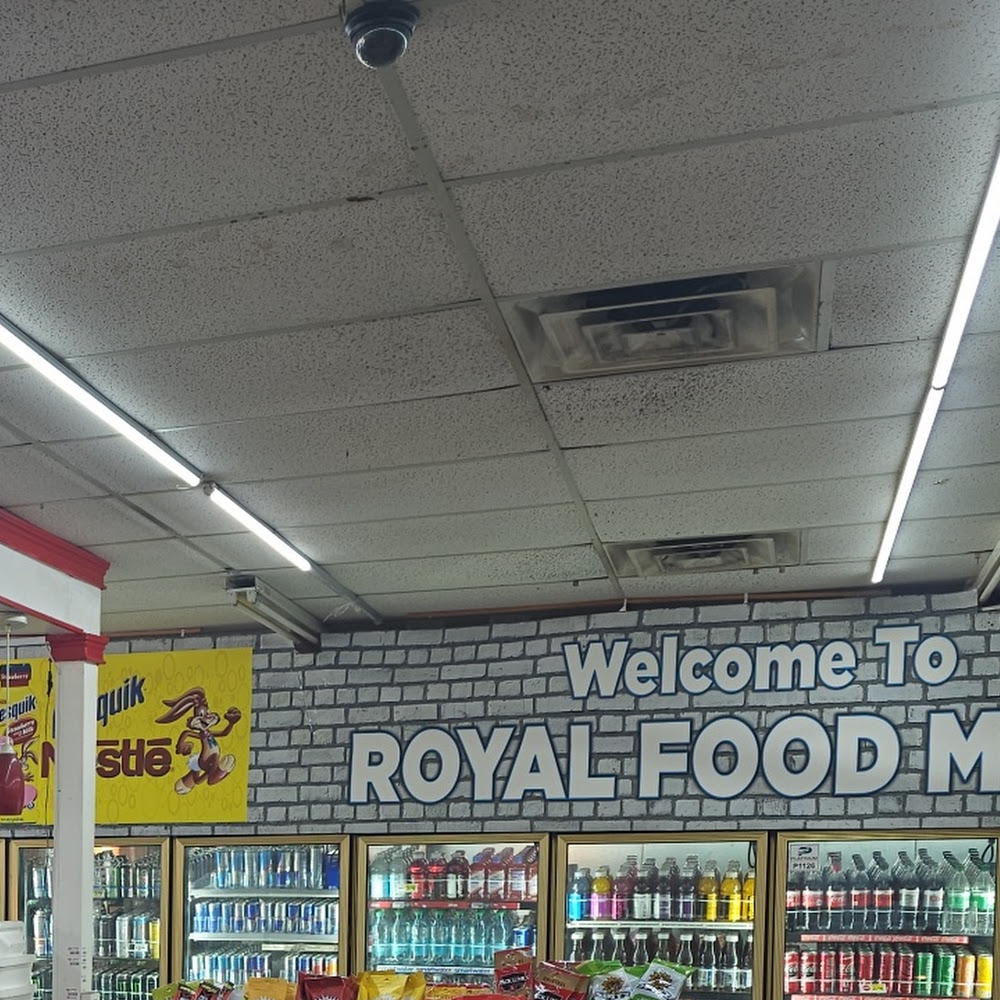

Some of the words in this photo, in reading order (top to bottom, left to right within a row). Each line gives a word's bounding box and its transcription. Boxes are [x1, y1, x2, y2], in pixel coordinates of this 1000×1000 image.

[561, 633, 858, 699] Welcome
[873, 622, 960, 688] To
[348, 721, 618, 806] ROYAL
[637, 710, 902, 801] FOOD
